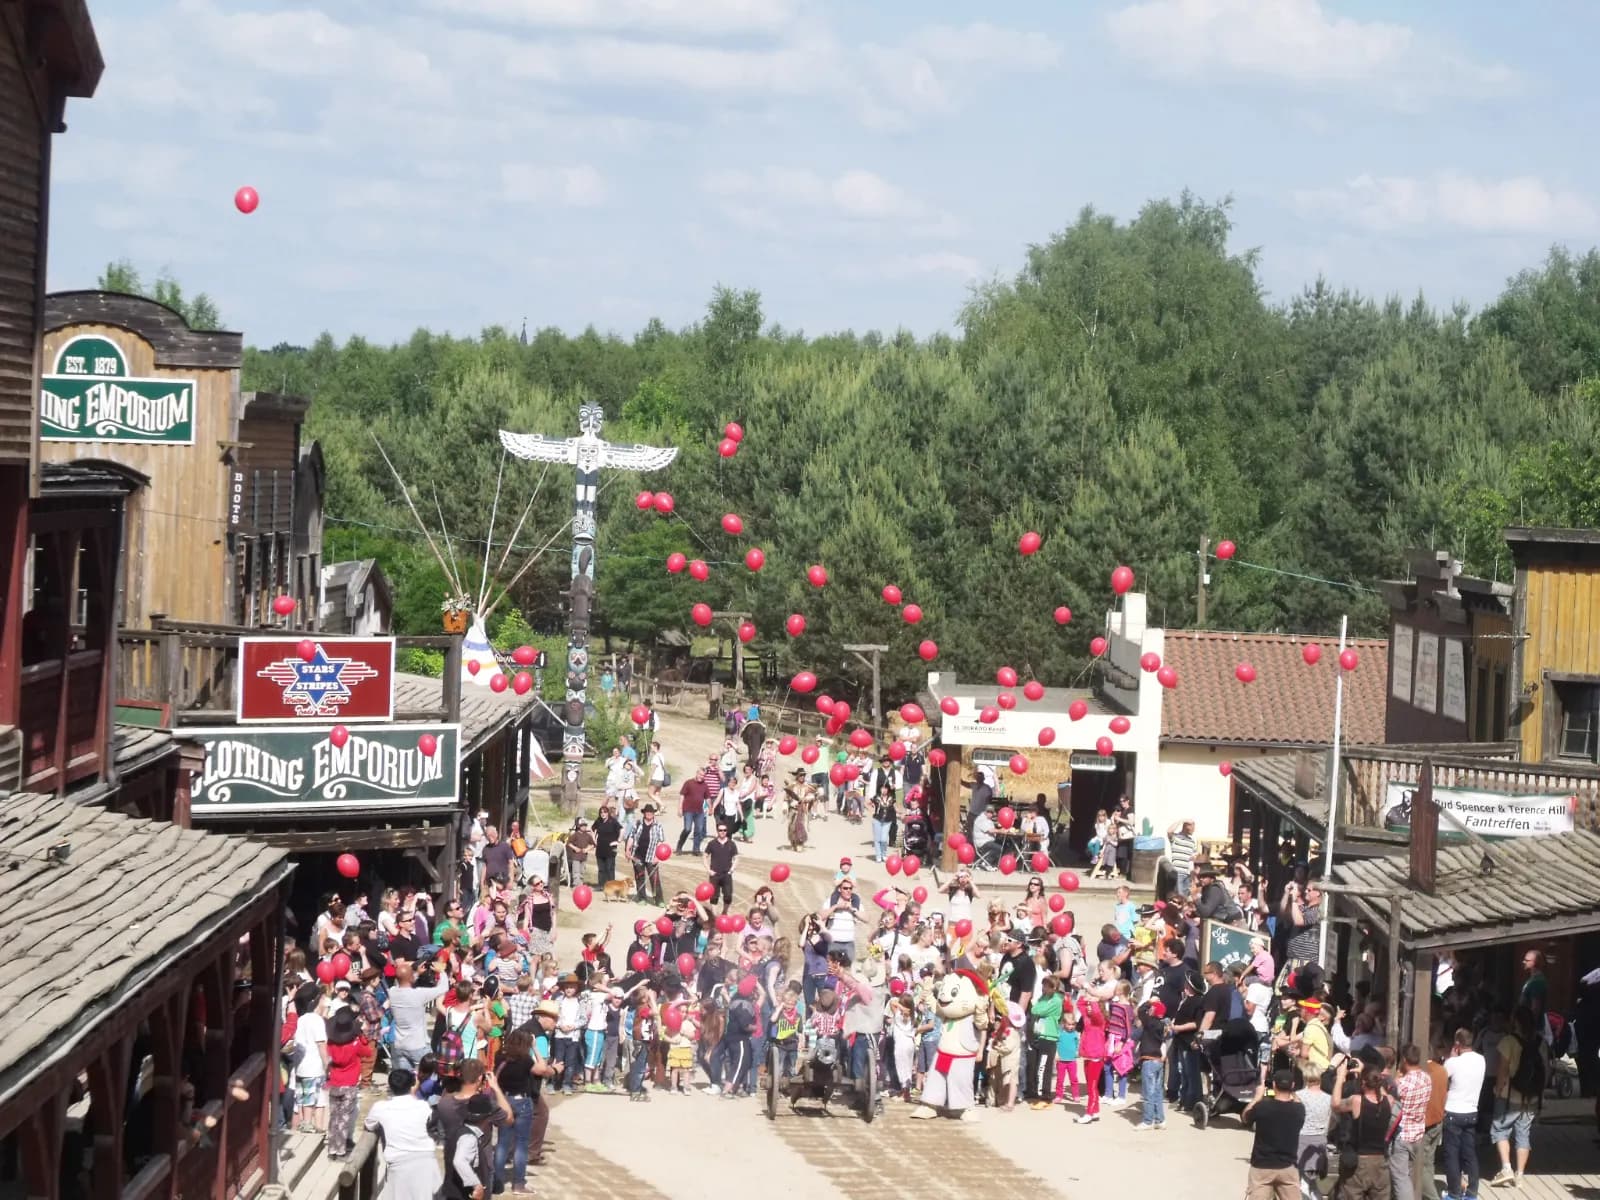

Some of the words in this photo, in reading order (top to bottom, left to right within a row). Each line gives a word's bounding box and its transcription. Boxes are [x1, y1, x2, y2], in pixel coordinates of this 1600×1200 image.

[65, 356, 87, 374] EST.
[94, 357, 117, 374] 1879
[84, 382, 190, 431] EMPORIUM
[231, 472, 243, 524] BOOTS
[301, 664, 335, 674] STARS
[296, 682, 339, 690] STRIPES
[312, 734, 444, 789] EMPORIUM
[1455, 801, 1496, 813] Spencer
[1497, 805, 1505, 813] &
[1508, 805, 1546, 815] Terence
[1548, 806, 1566, 815] Hill
[1465, 815, 1530, 830] Fantreffen
